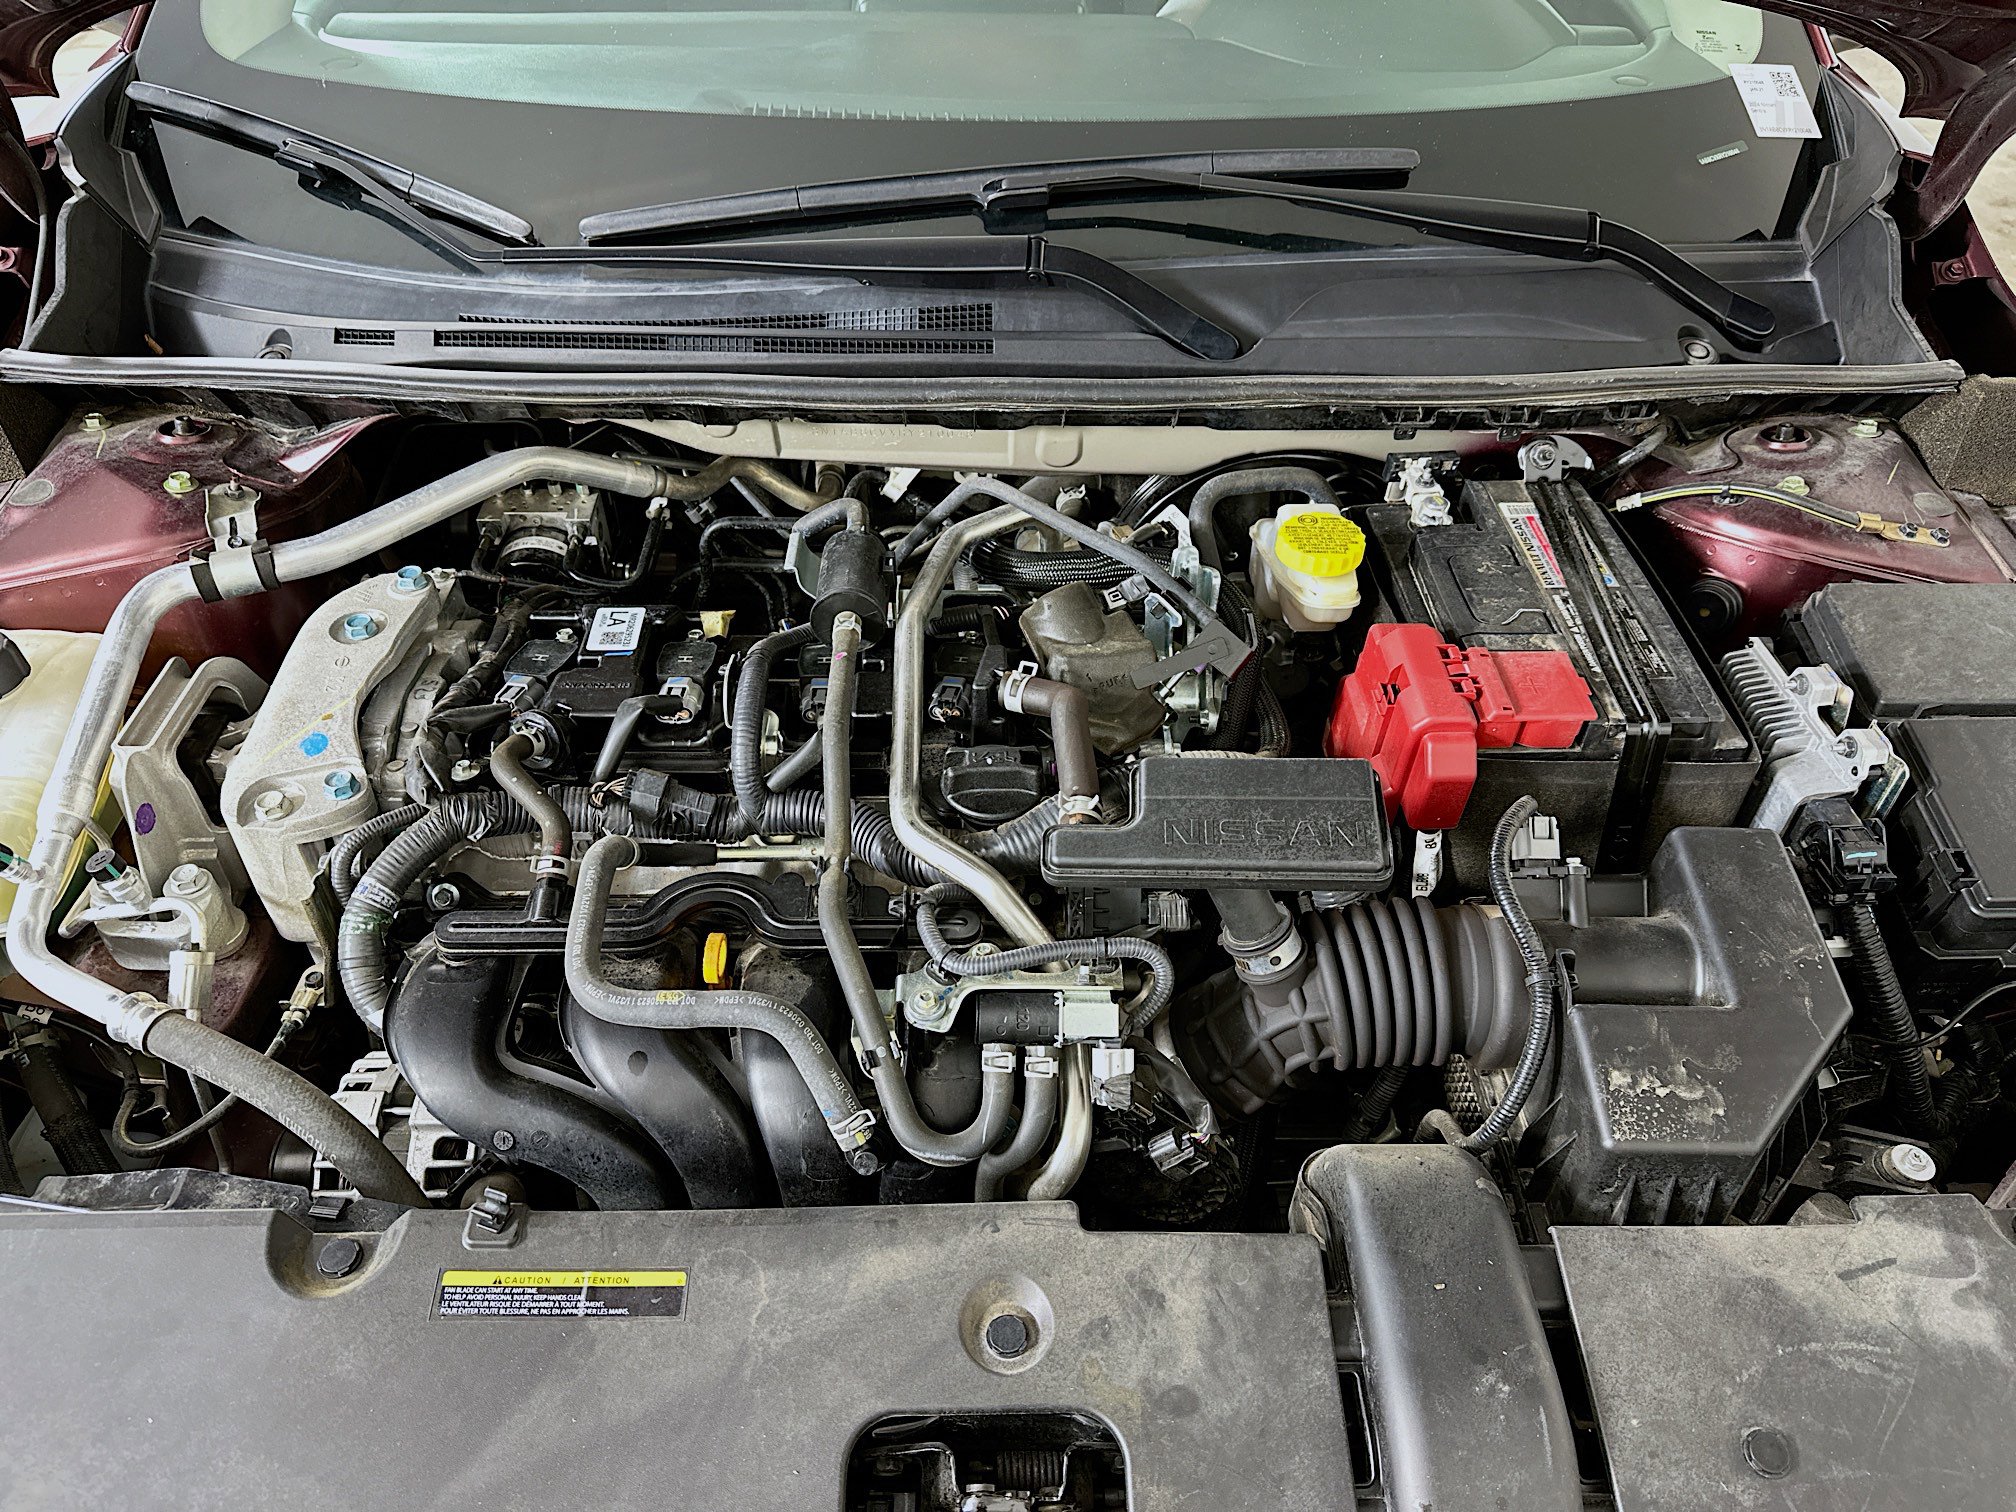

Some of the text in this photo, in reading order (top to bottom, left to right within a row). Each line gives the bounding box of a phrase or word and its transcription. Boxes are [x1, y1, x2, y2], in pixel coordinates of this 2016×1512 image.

[1509, 517, 1534, 552] NISSAN
[607, 611, 629, 627] LA
[1163, 817, 1367, 848] NISSAN
[811, 1039, 825, 1055] DOT
[504, 1276, 551, 1284] CAUTION
[574, 1276, 630, 1284] ATTENTION
[450, 1300, 489, 1308] VENTILATEUR
